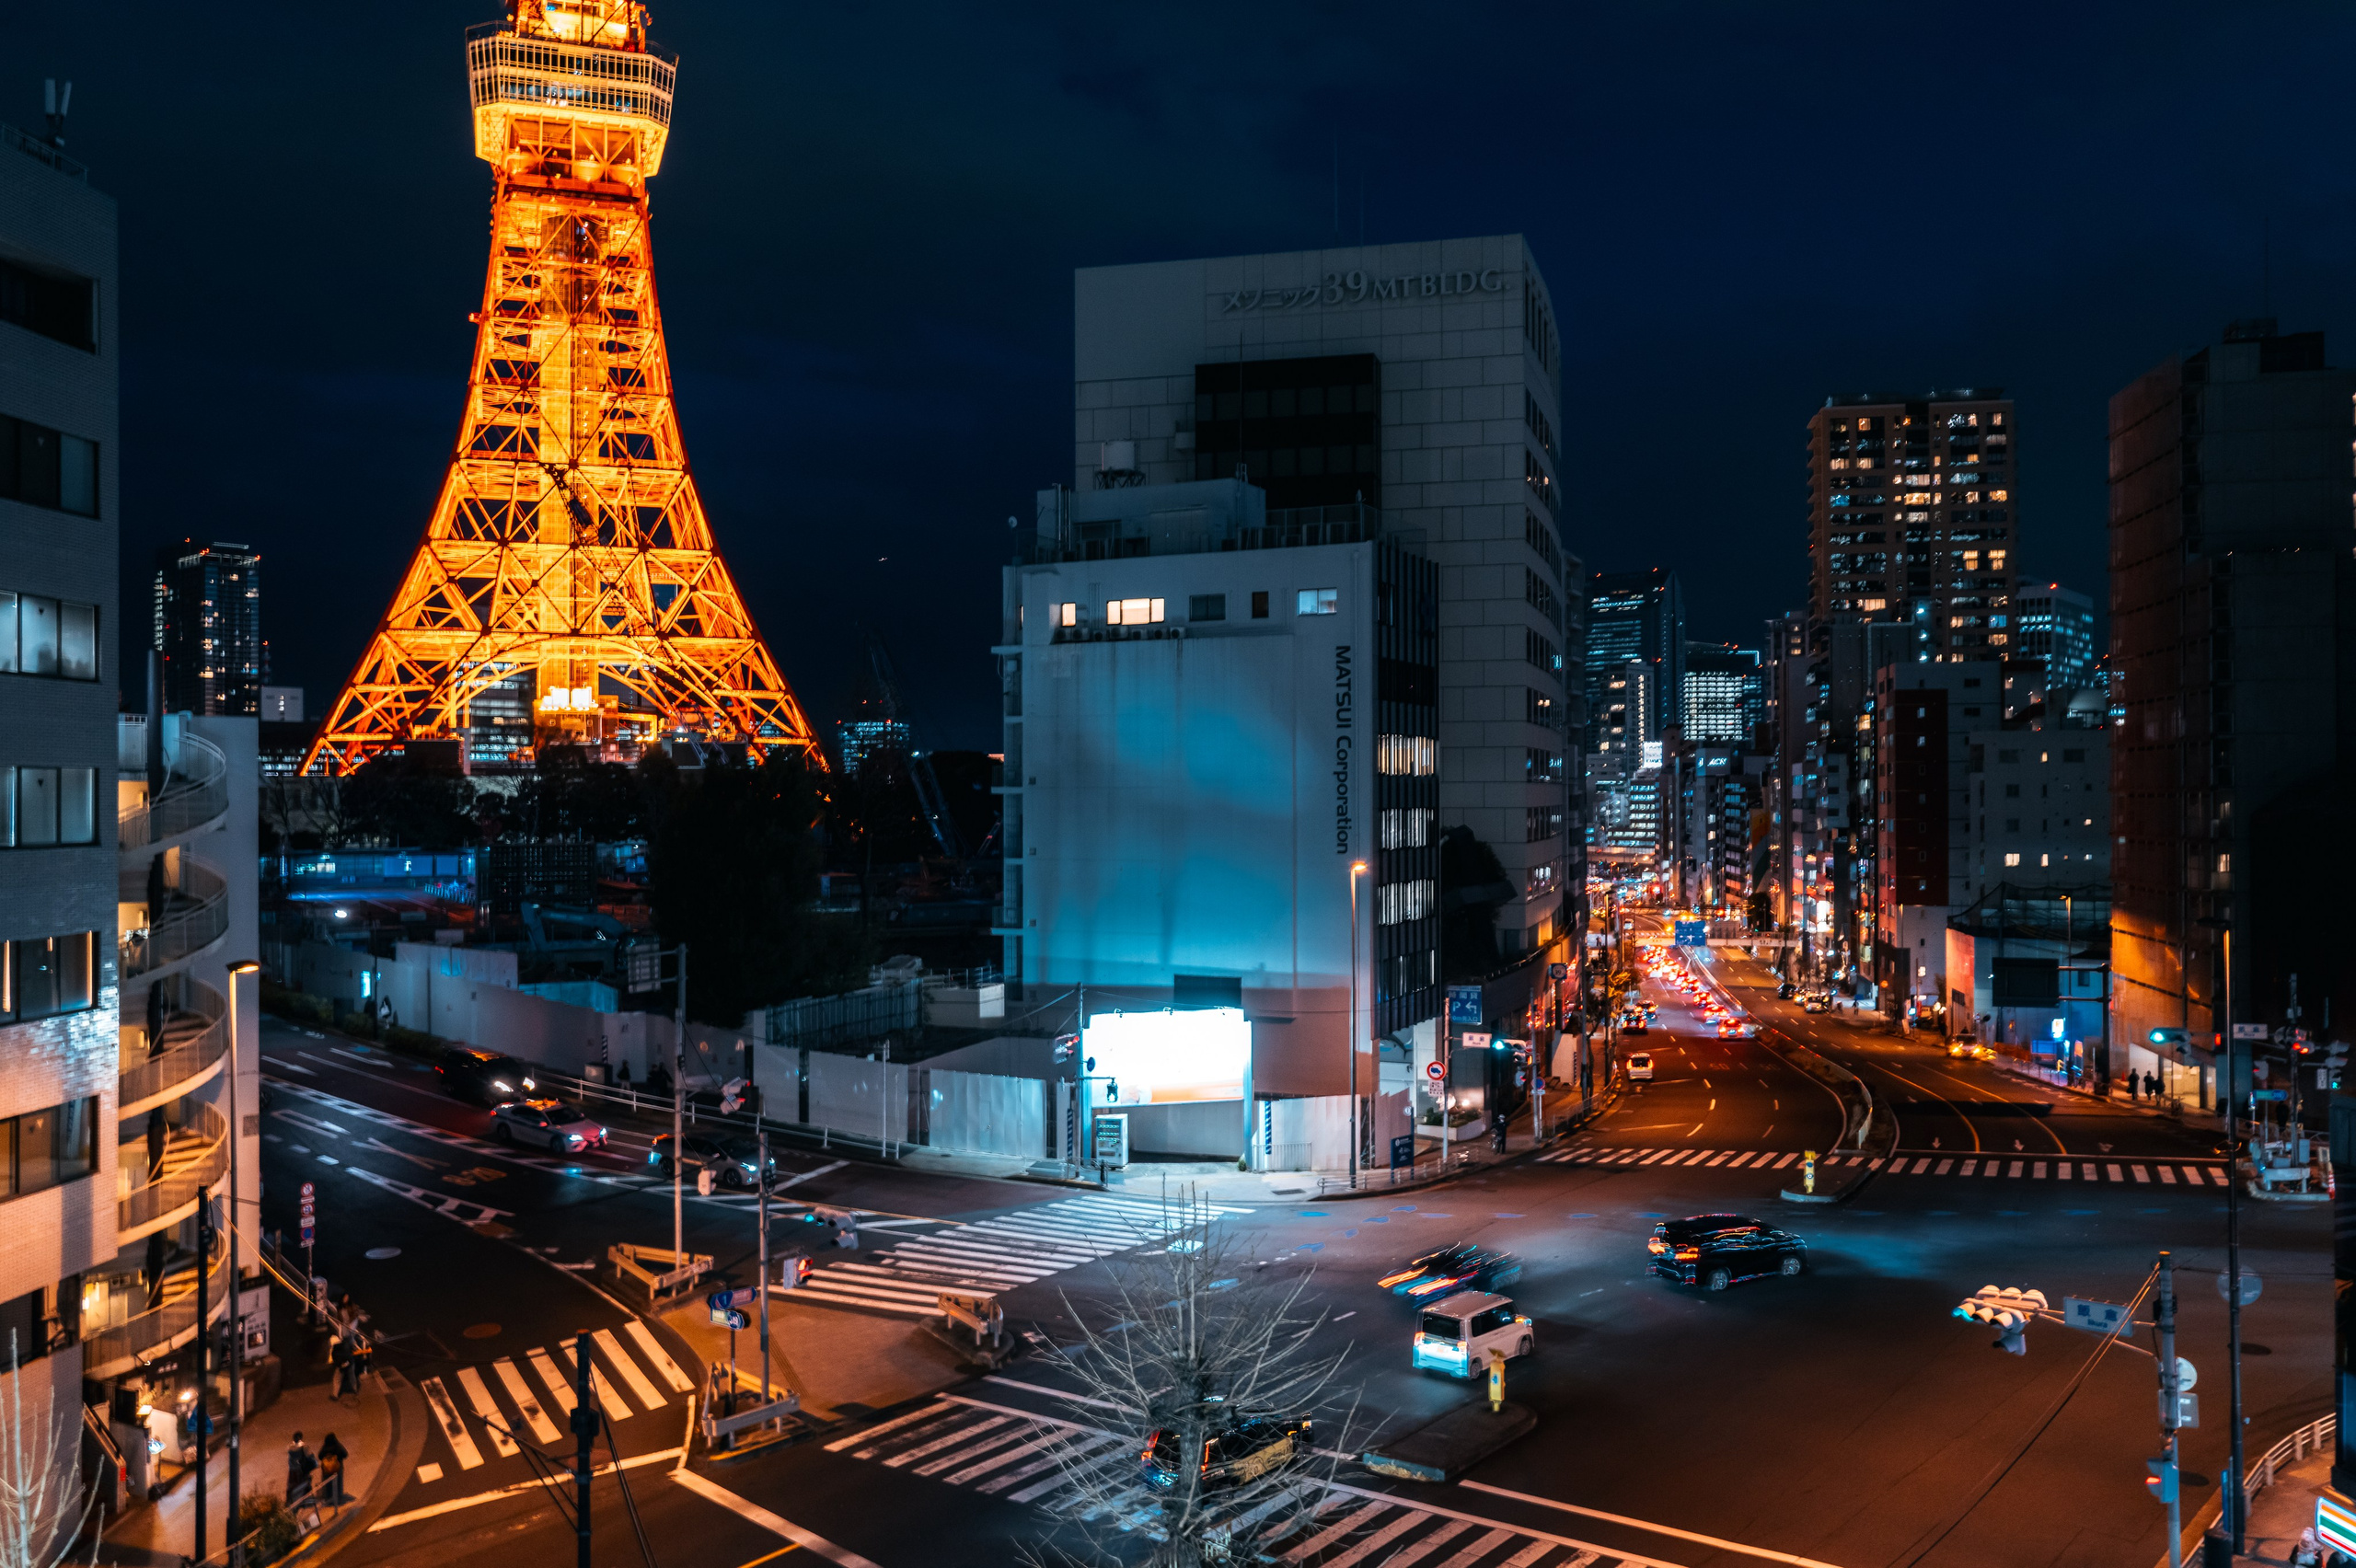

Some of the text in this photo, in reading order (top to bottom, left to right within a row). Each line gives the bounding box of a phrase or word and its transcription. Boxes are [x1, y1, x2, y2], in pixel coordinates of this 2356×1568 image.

[1334, 645, 1352, 855] MATSUI Corporation
[1452, 1001, 1461, 1012] P
